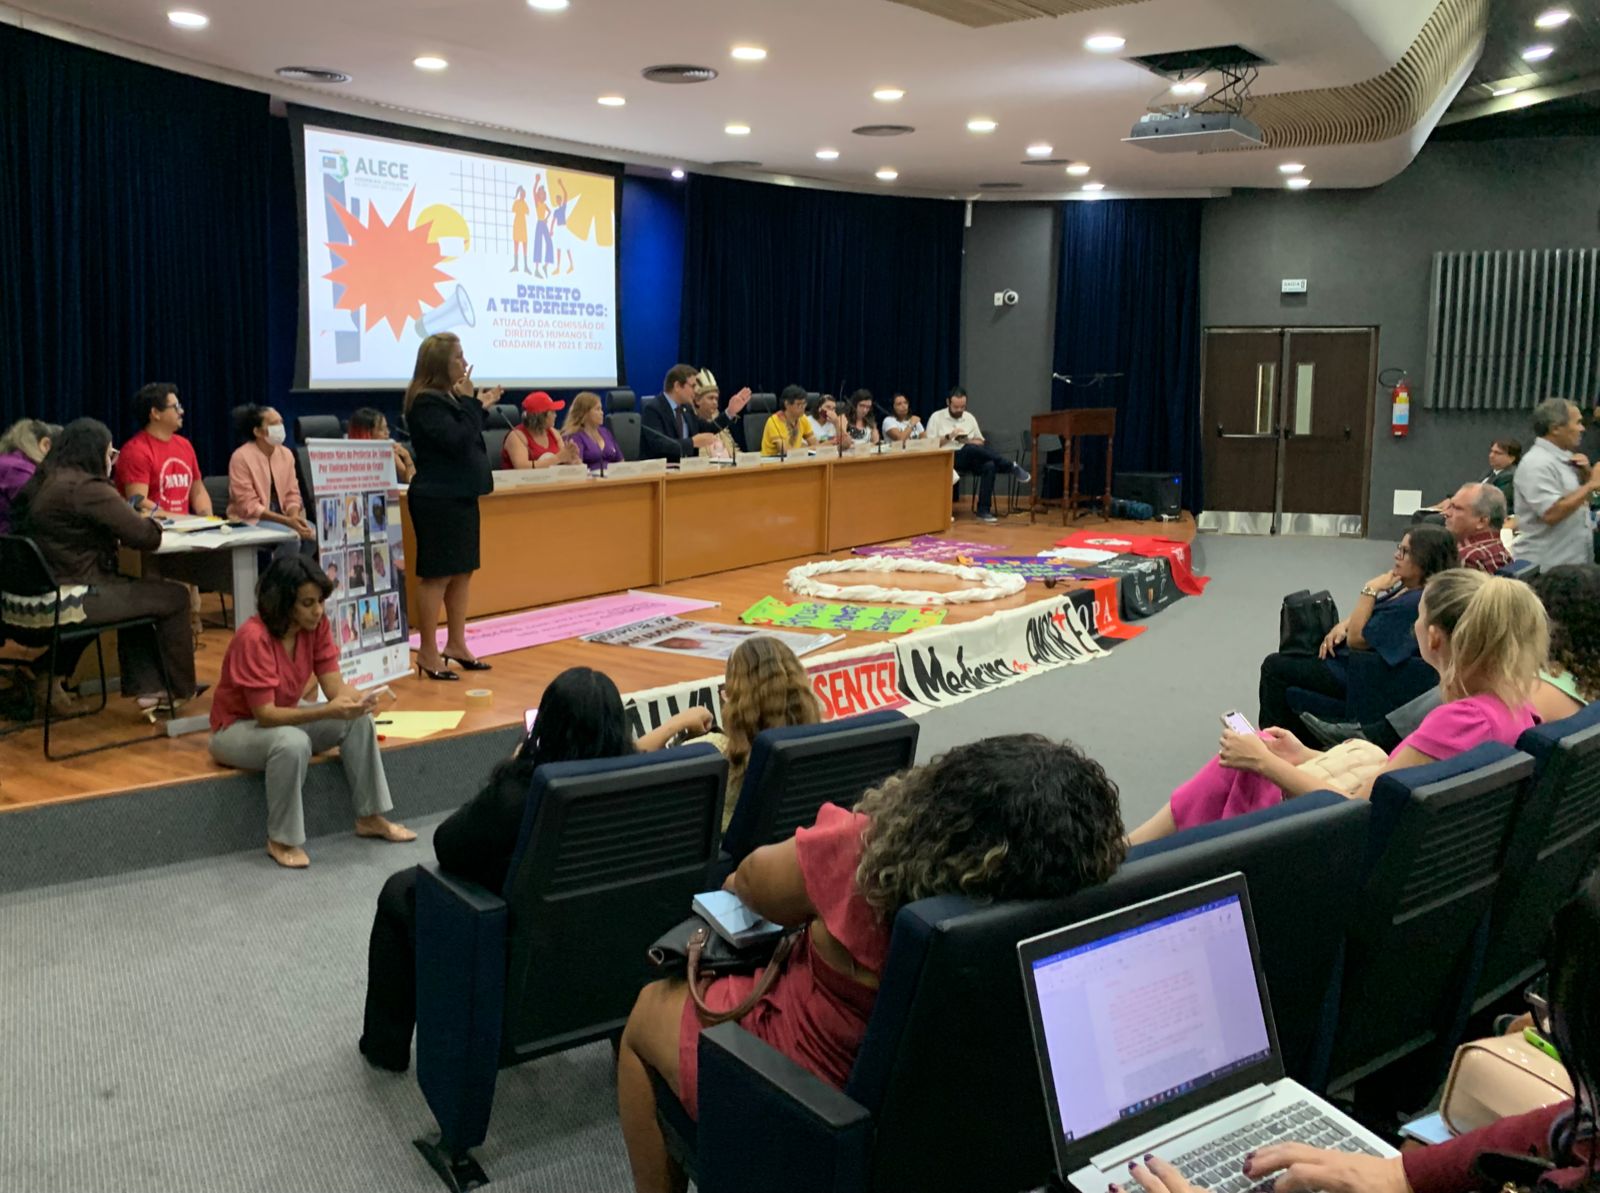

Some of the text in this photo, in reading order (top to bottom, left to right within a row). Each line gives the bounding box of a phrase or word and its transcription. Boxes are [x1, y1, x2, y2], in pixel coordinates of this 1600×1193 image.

[355, 157, 409, 180] ALECE
[517, 284, 581, 301] DIREITO
[486, 297, 608, 317] A TER DIREITOS:
[492, 317, 605, 330] ATUAÇÃO DA COMISSÃO DE
[504, 329, 544, 339] DIREITOS
[546, 330, 588, 340] HUMANOS
[492, 339, 541, 349] CIDADANIA
[543, 341, 556, 349] EM
[910, 644, 1021, 702] Medicina
[807, 660, 902, 721] SENTE!
